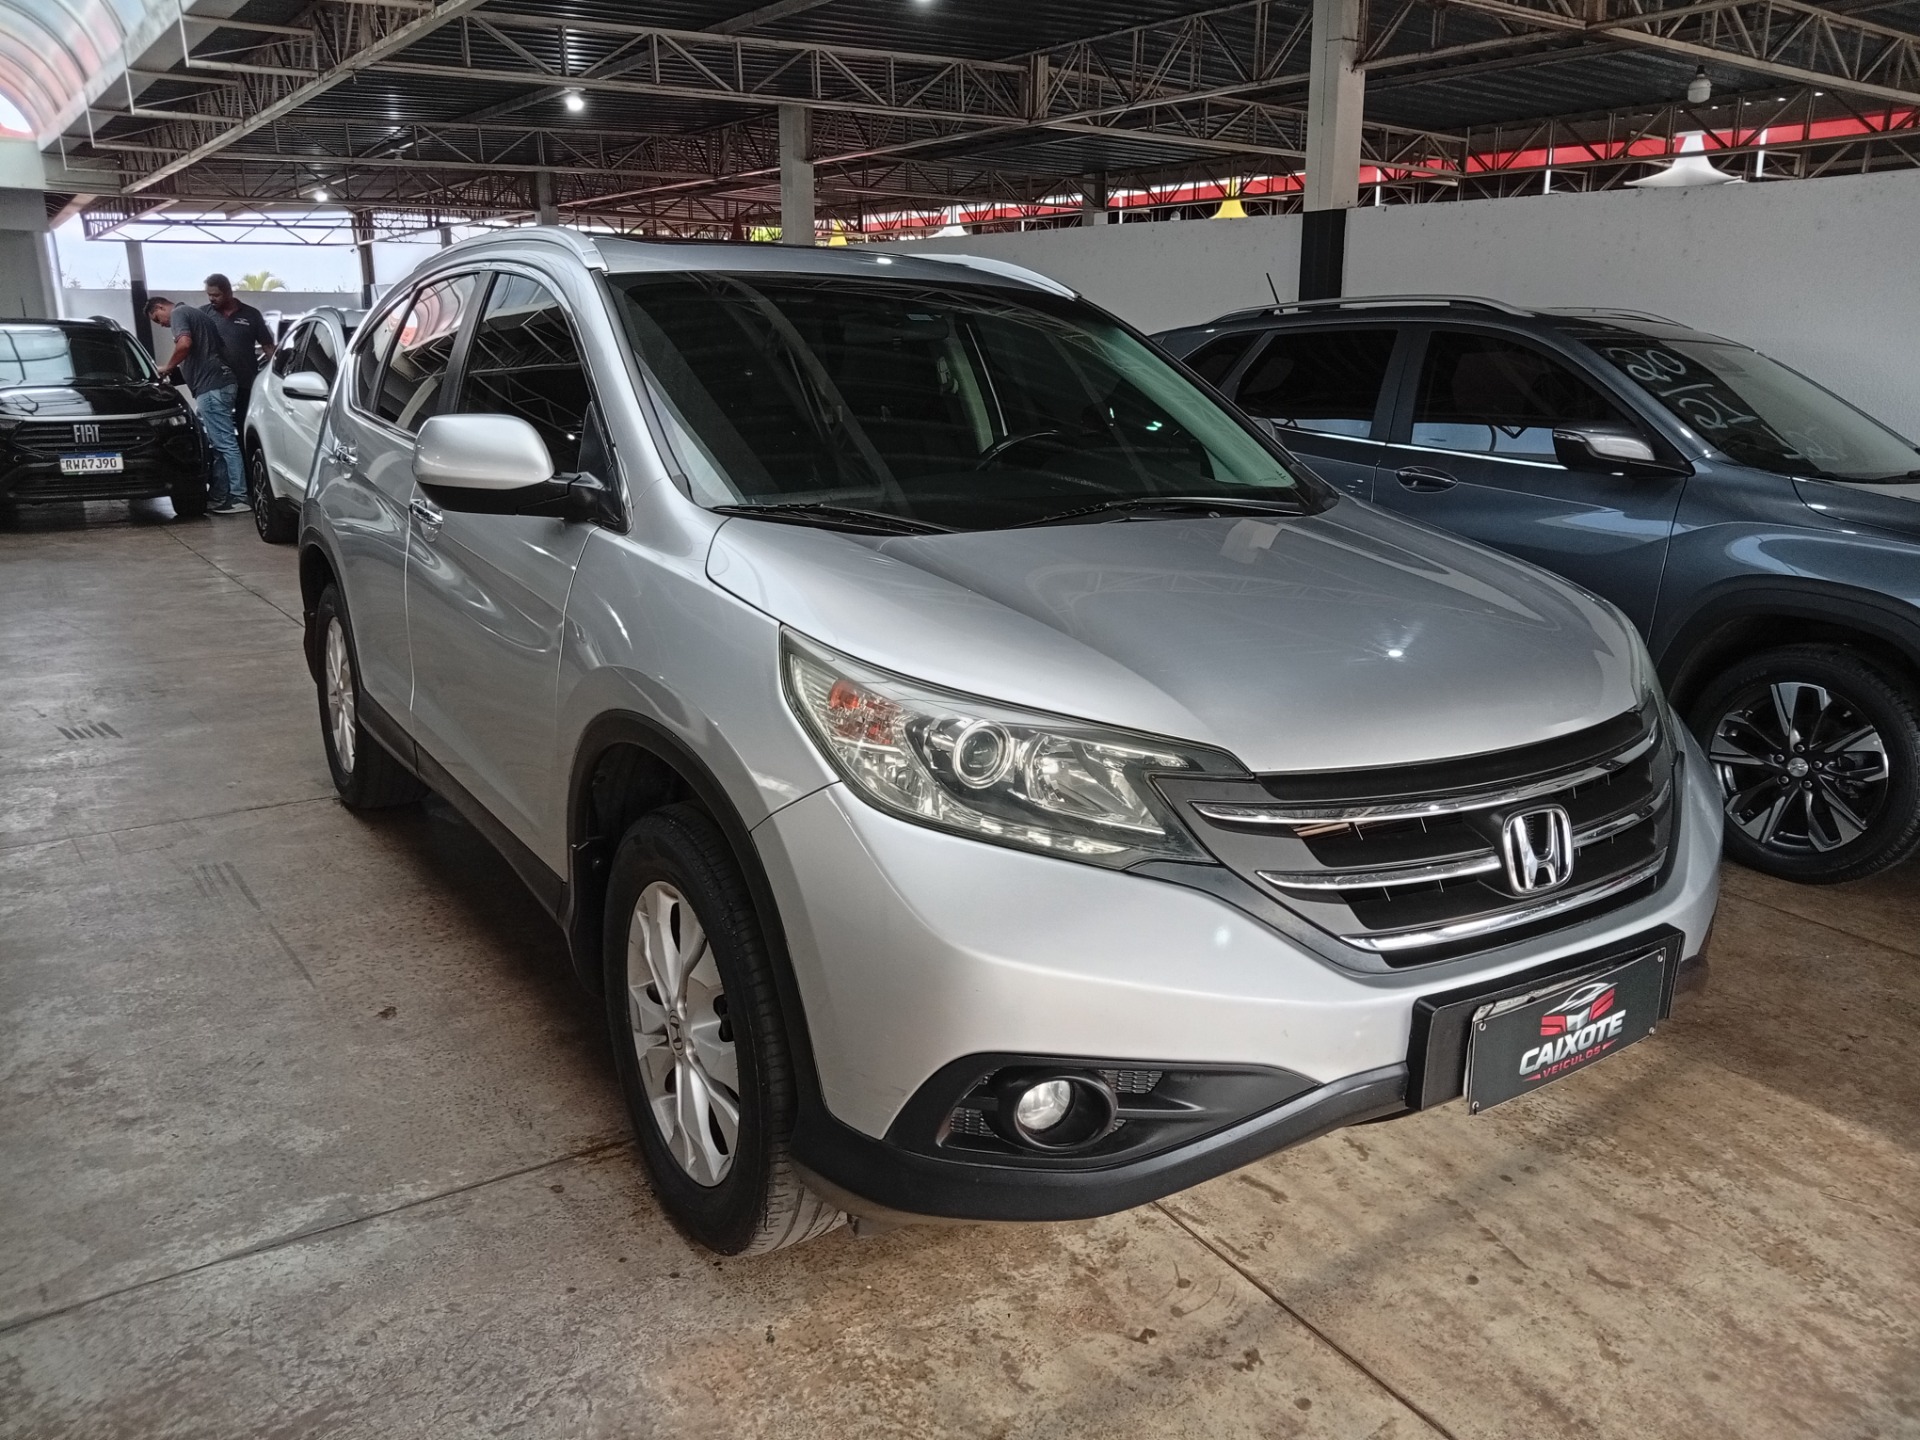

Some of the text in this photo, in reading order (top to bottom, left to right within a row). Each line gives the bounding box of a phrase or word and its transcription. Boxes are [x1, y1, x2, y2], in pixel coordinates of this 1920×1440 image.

[73, 424, 100, 443] FIAT
[66, 457, 117, 470] RWA7J90
[1519, 1009, 1627, 1076] CAIXOTE
[1543, 1047, 1602, 1078] VEICULOS
